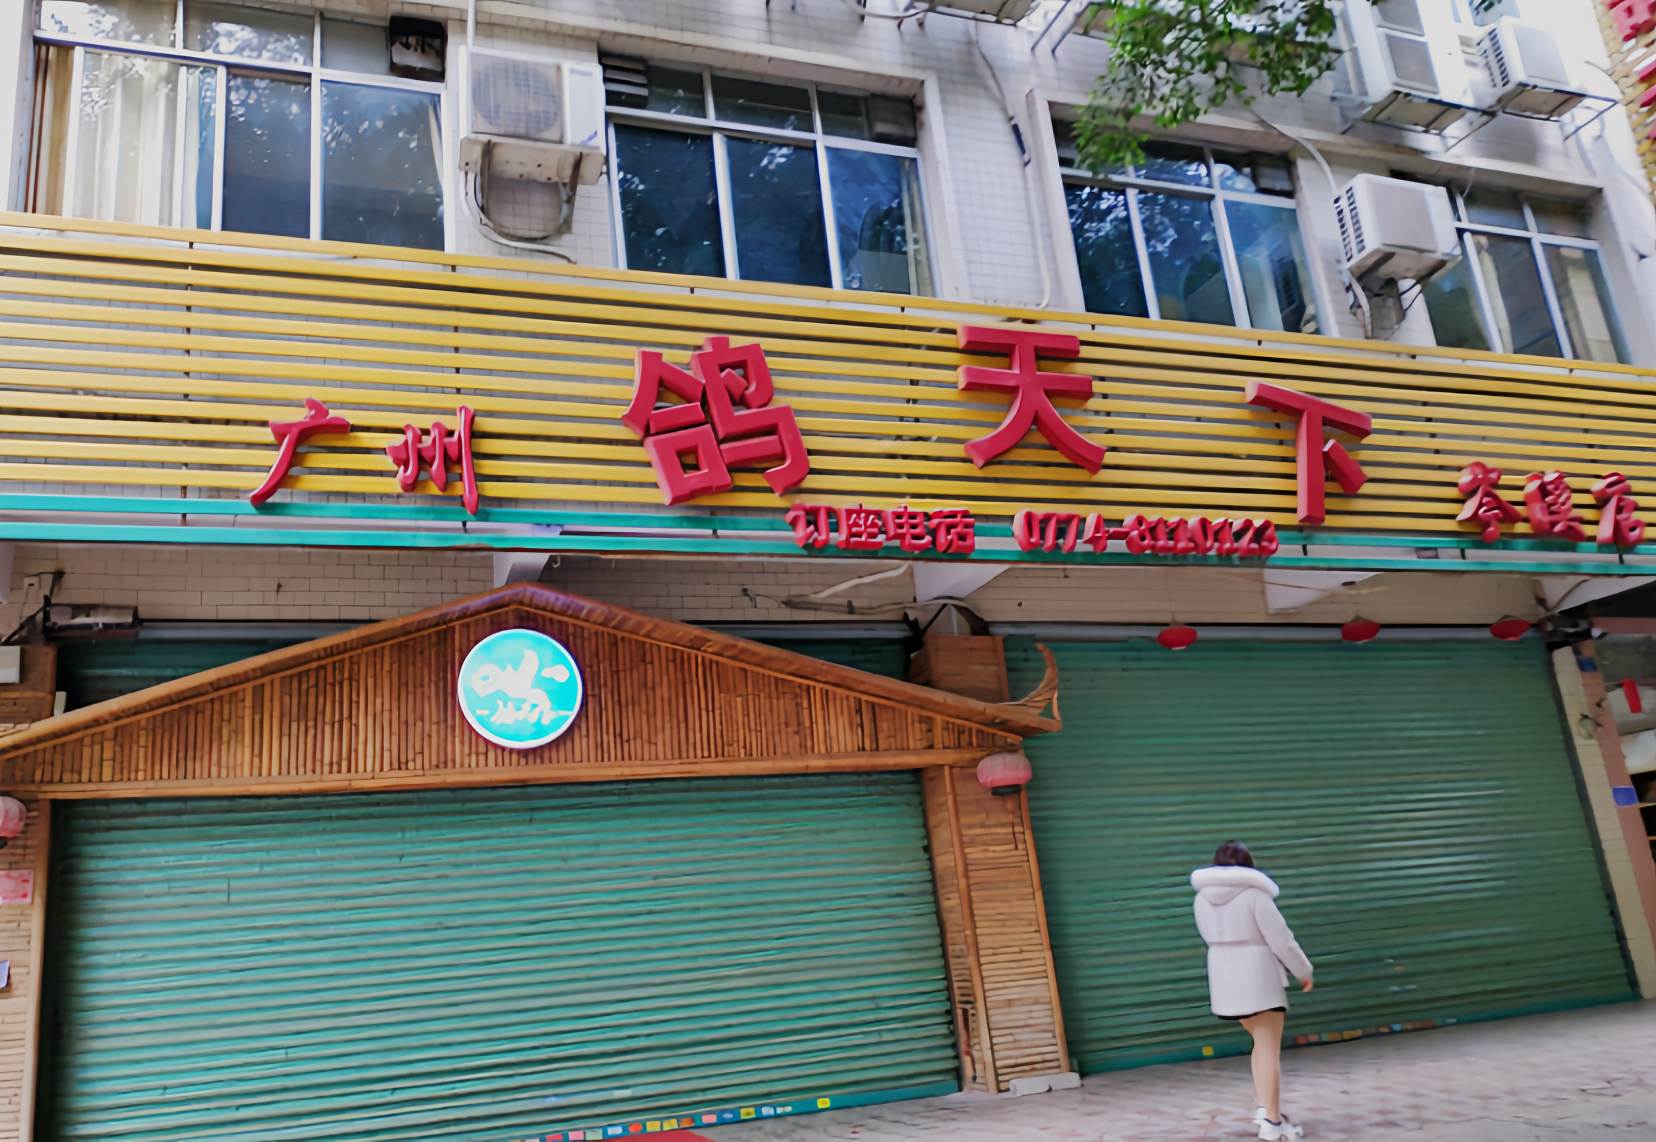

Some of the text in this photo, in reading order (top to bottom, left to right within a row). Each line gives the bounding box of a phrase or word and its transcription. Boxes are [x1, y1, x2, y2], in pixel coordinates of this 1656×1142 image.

[249, 397, 479, 515] 广州
[621, 324, 1372, 526] 鸽天下
[785, 503, 976, 555] 订座电话
